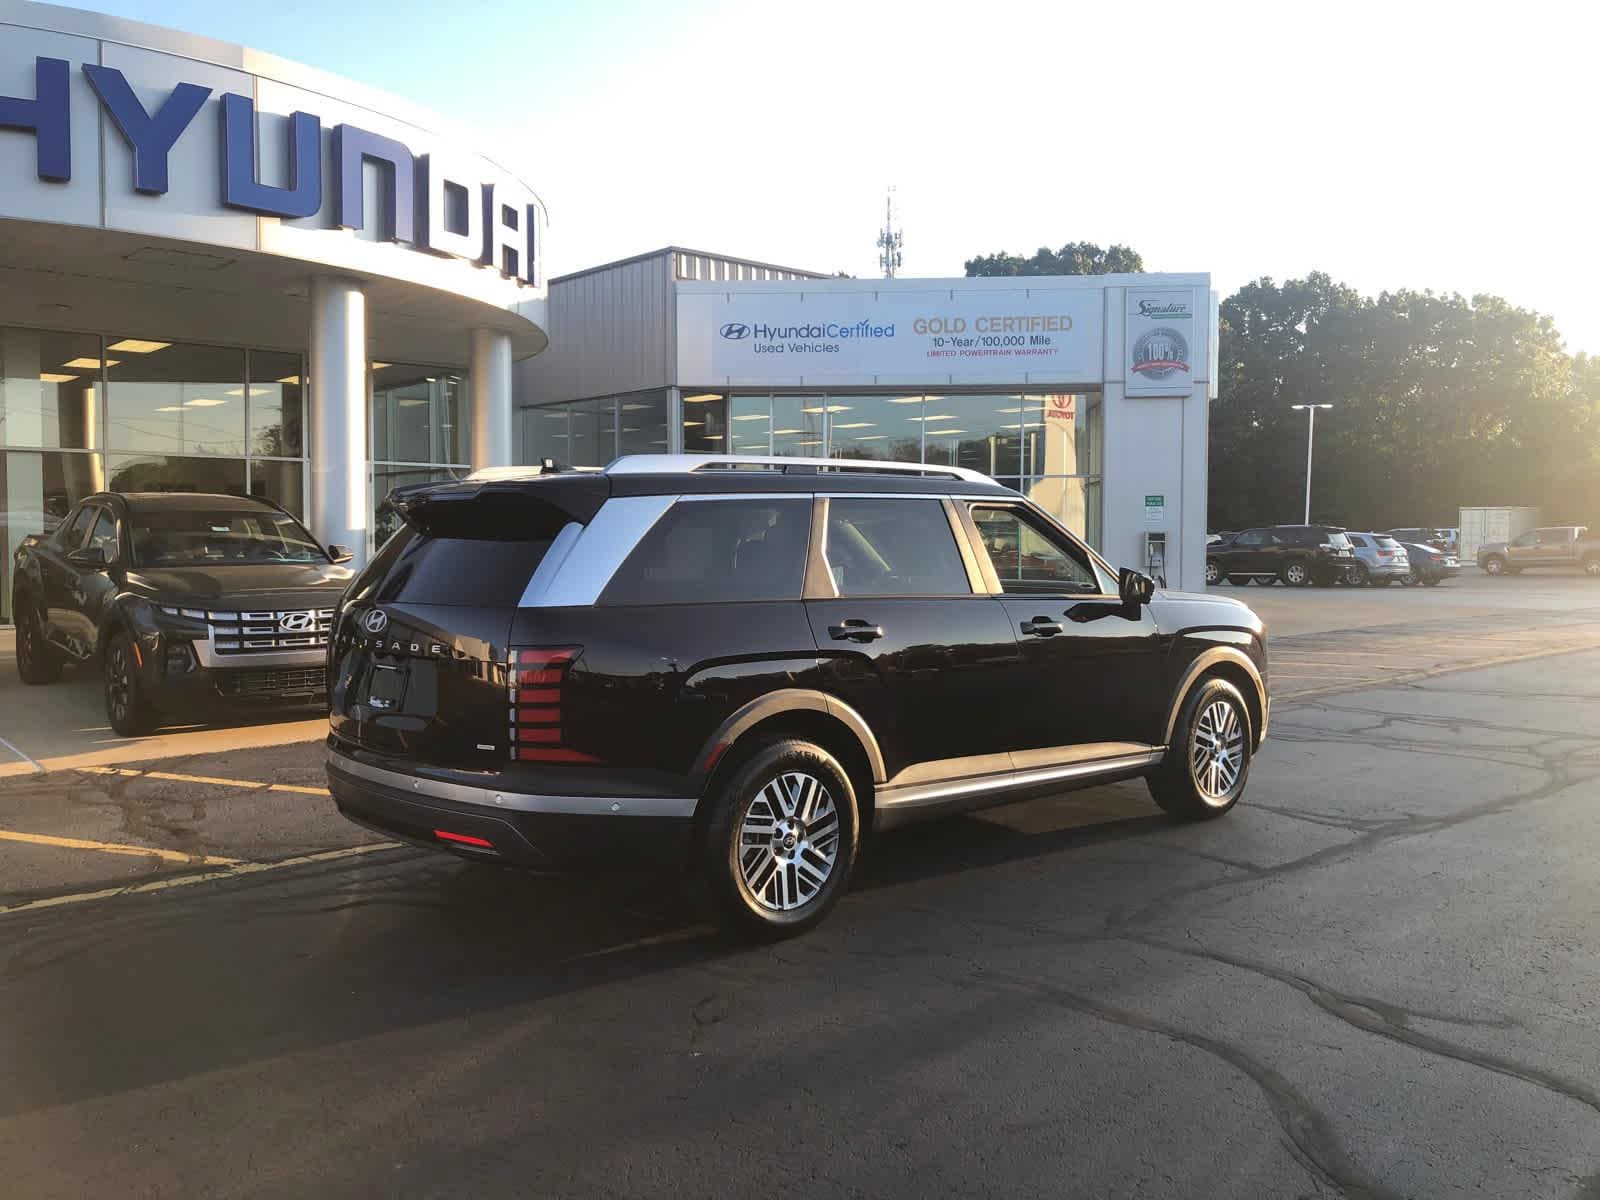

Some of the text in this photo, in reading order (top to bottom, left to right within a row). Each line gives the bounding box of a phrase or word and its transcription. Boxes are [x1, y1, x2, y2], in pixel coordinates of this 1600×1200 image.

[0, 55, 541, 288] HYUNDAI
[1136, 299, 1187, 317] Signature
[753, 319, 895, 341] HyundaiCertified
[912, 315, 1073, 335] GOLD CERTIFIED
[754, 343, 840, 353] Used Vehicles
[933, 335, 1051, 348] 10-Year/100,000 Mile
[926, 348, 1059, 358] LIMITED POWERTRAIN WARRANTY
[1148, 343, 1175, 361] 100%
